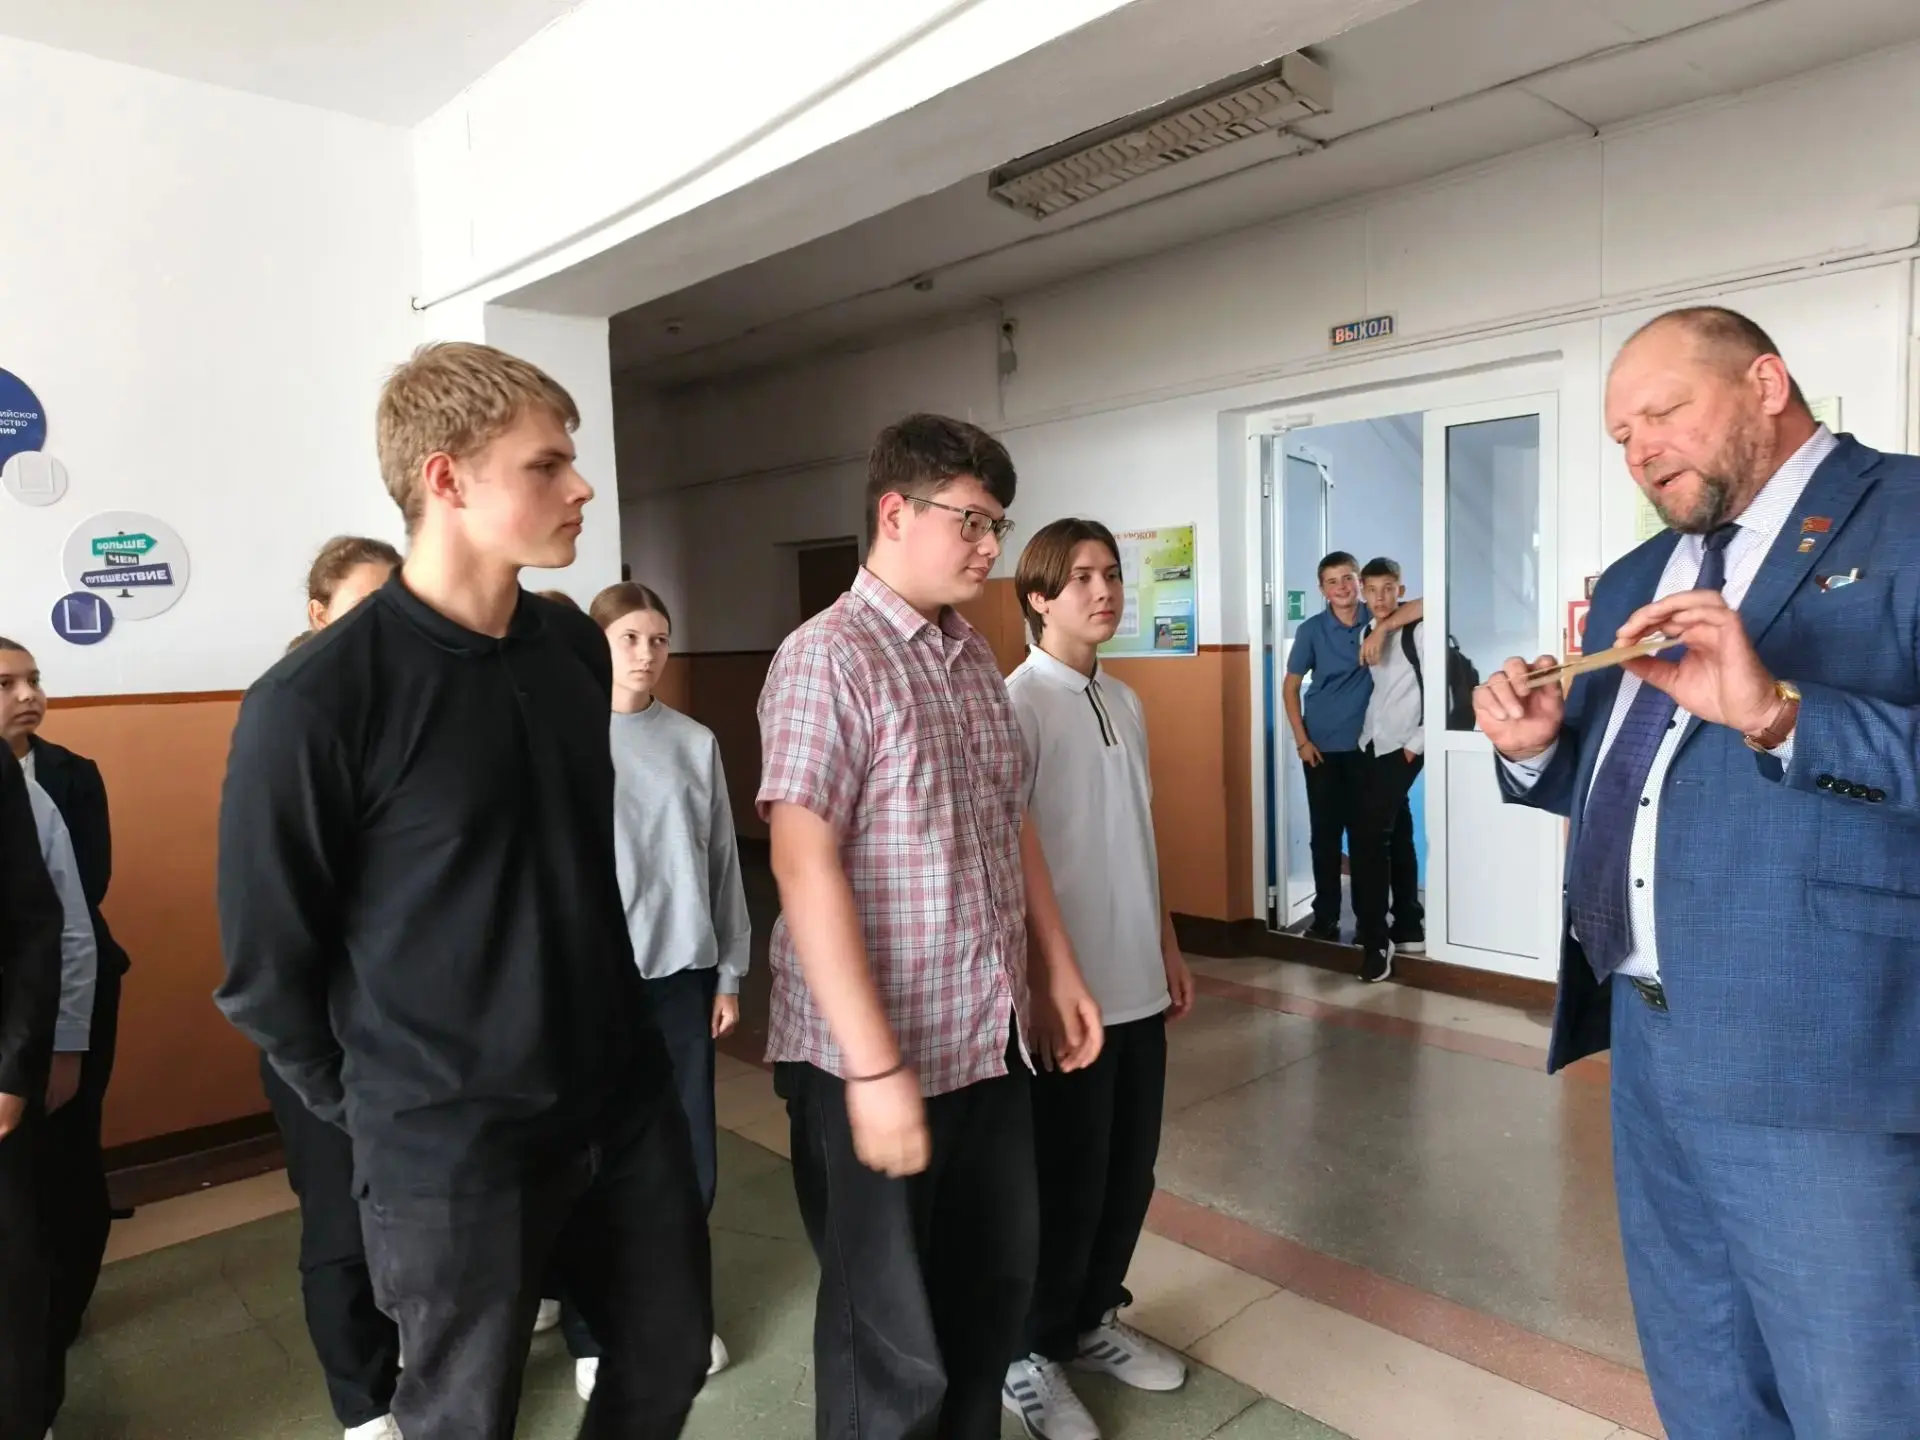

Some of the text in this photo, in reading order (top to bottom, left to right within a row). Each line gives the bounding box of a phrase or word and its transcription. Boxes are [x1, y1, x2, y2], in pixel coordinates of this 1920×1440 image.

[1335, 318, 1390, 343] ВЫХОД
[97, 539, 147, 550] БОЛЬШЕ
[108, 554, 138, 564] ЧЕМ
[85, 569, 168, 584] ПУТЕШЕСТВИЕ
